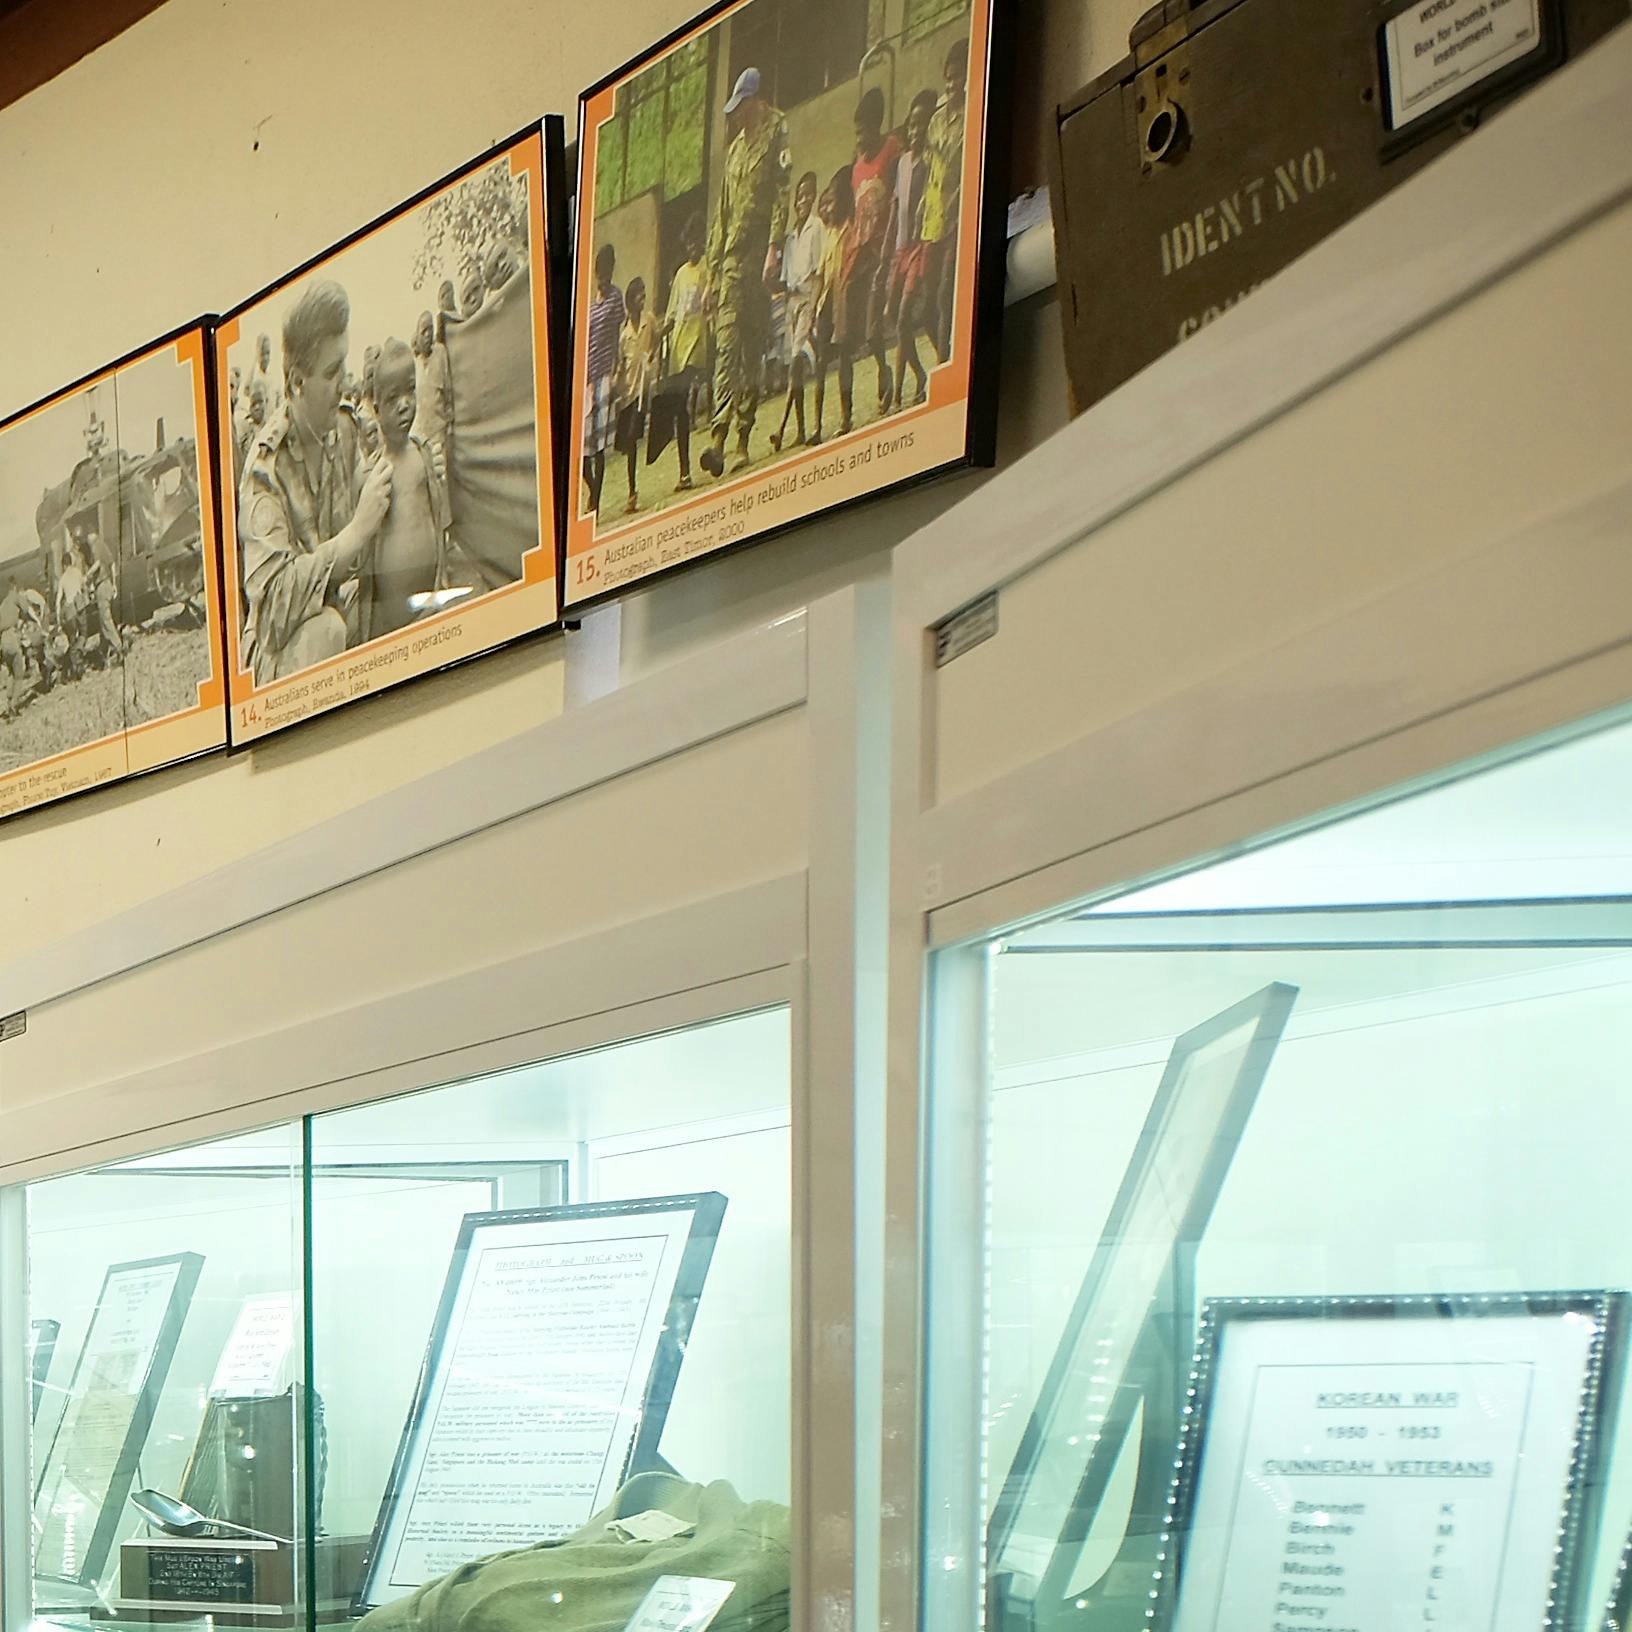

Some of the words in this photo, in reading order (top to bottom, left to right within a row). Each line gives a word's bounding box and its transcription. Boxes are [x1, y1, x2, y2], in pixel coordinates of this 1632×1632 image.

[1414, 38, 1434, 57] Box
[1437, 26, 1451, 42] for
[1455, 6, 1486, 31] bomb
[1434, 22, 1493, 66] instrument
[1160, 177, 1265, 276] IDENT
[1273, 146, 1336, 213] NO.
[576, 555, 601, 585] 15.
[604, 531, 653, 566] Australian
[656, 505, 726, 549] peacekeepers
[730, 494, 754, 517] help
[757, 473, 796, 506] rebuild
[800, 459, 845, 489] schools
[849, 444, 872, 469] and
[877, 431, 915, 462] towns
[241, 706, 262, 728] 14.
[265, 684, 309, 712] Australians
[311, 675, 334, 695] serve
[348, 647, 410, 683] peacekeeping
[412, 623, 463, 654] operations
[29, 776, 42, 788] the
[44, 767, 68, 784] rescue
[1317, 1392, 1403, 1406] KOREAN
[1412, 1392, 1460, 1406] WAR
[1325, 1426, 1369, 1439] 1950
[1398, 1426, 1441, 1440] 1953
[1263, 1460, 1374, 1474] GUNNEDAH
[1386, 1460, 1494, 1475] VETERANS
[1285, 1542, 1336, 1555] Birch
[1281, 1562, 1344, 1576] Maude
[1275, 1603, 1328, 1620] Percy
